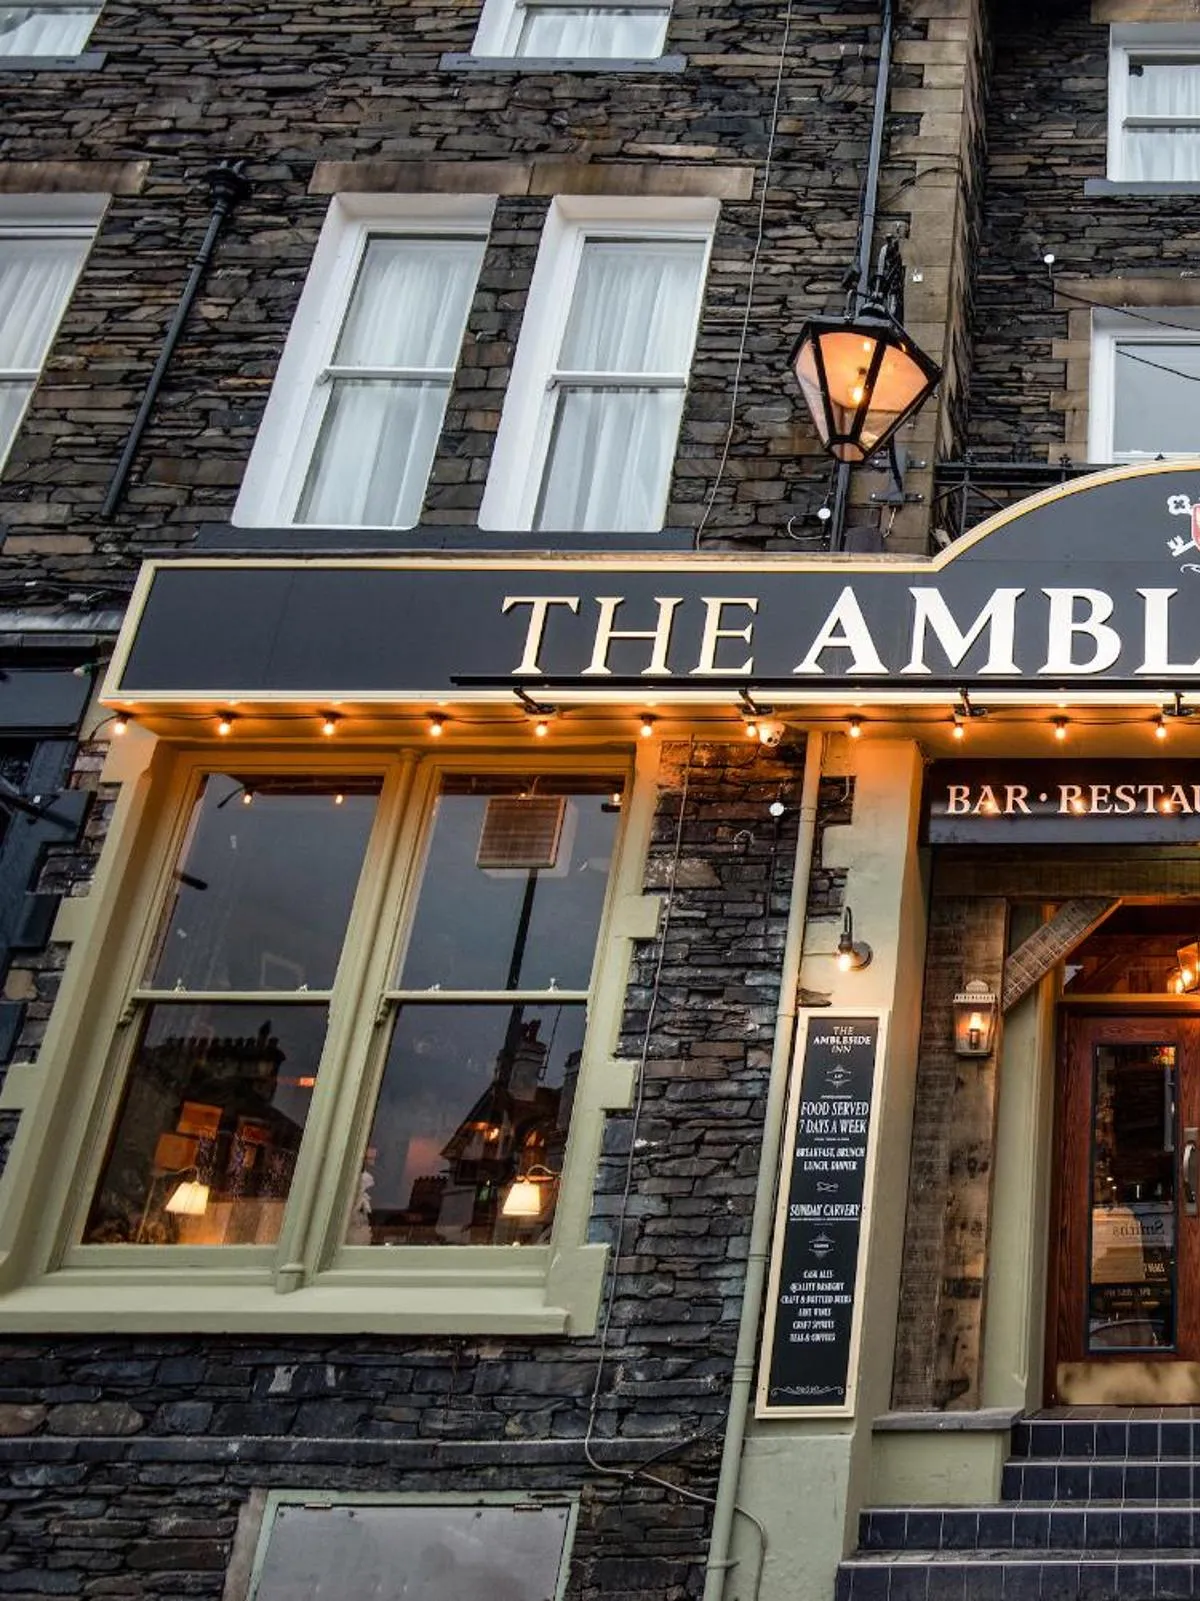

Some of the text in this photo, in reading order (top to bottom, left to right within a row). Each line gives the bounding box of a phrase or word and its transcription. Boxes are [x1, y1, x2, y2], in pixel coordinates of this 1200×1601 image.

[501, 595, 760, 677] THE
[946, 784, 1034, 814] BAR
[833, 1026, 855, 1036] THE
[813, 1036, 872, 1046] AMBLESIDE
[831, 1045, 852, 1054] INN
[800, 1101, 870, 1116] FOOD SERVED
[800, 1119, 868, 1134] 7 DAYS A WEEK
[789, 1203, 861, 1217] SUNDAY CARVERY
